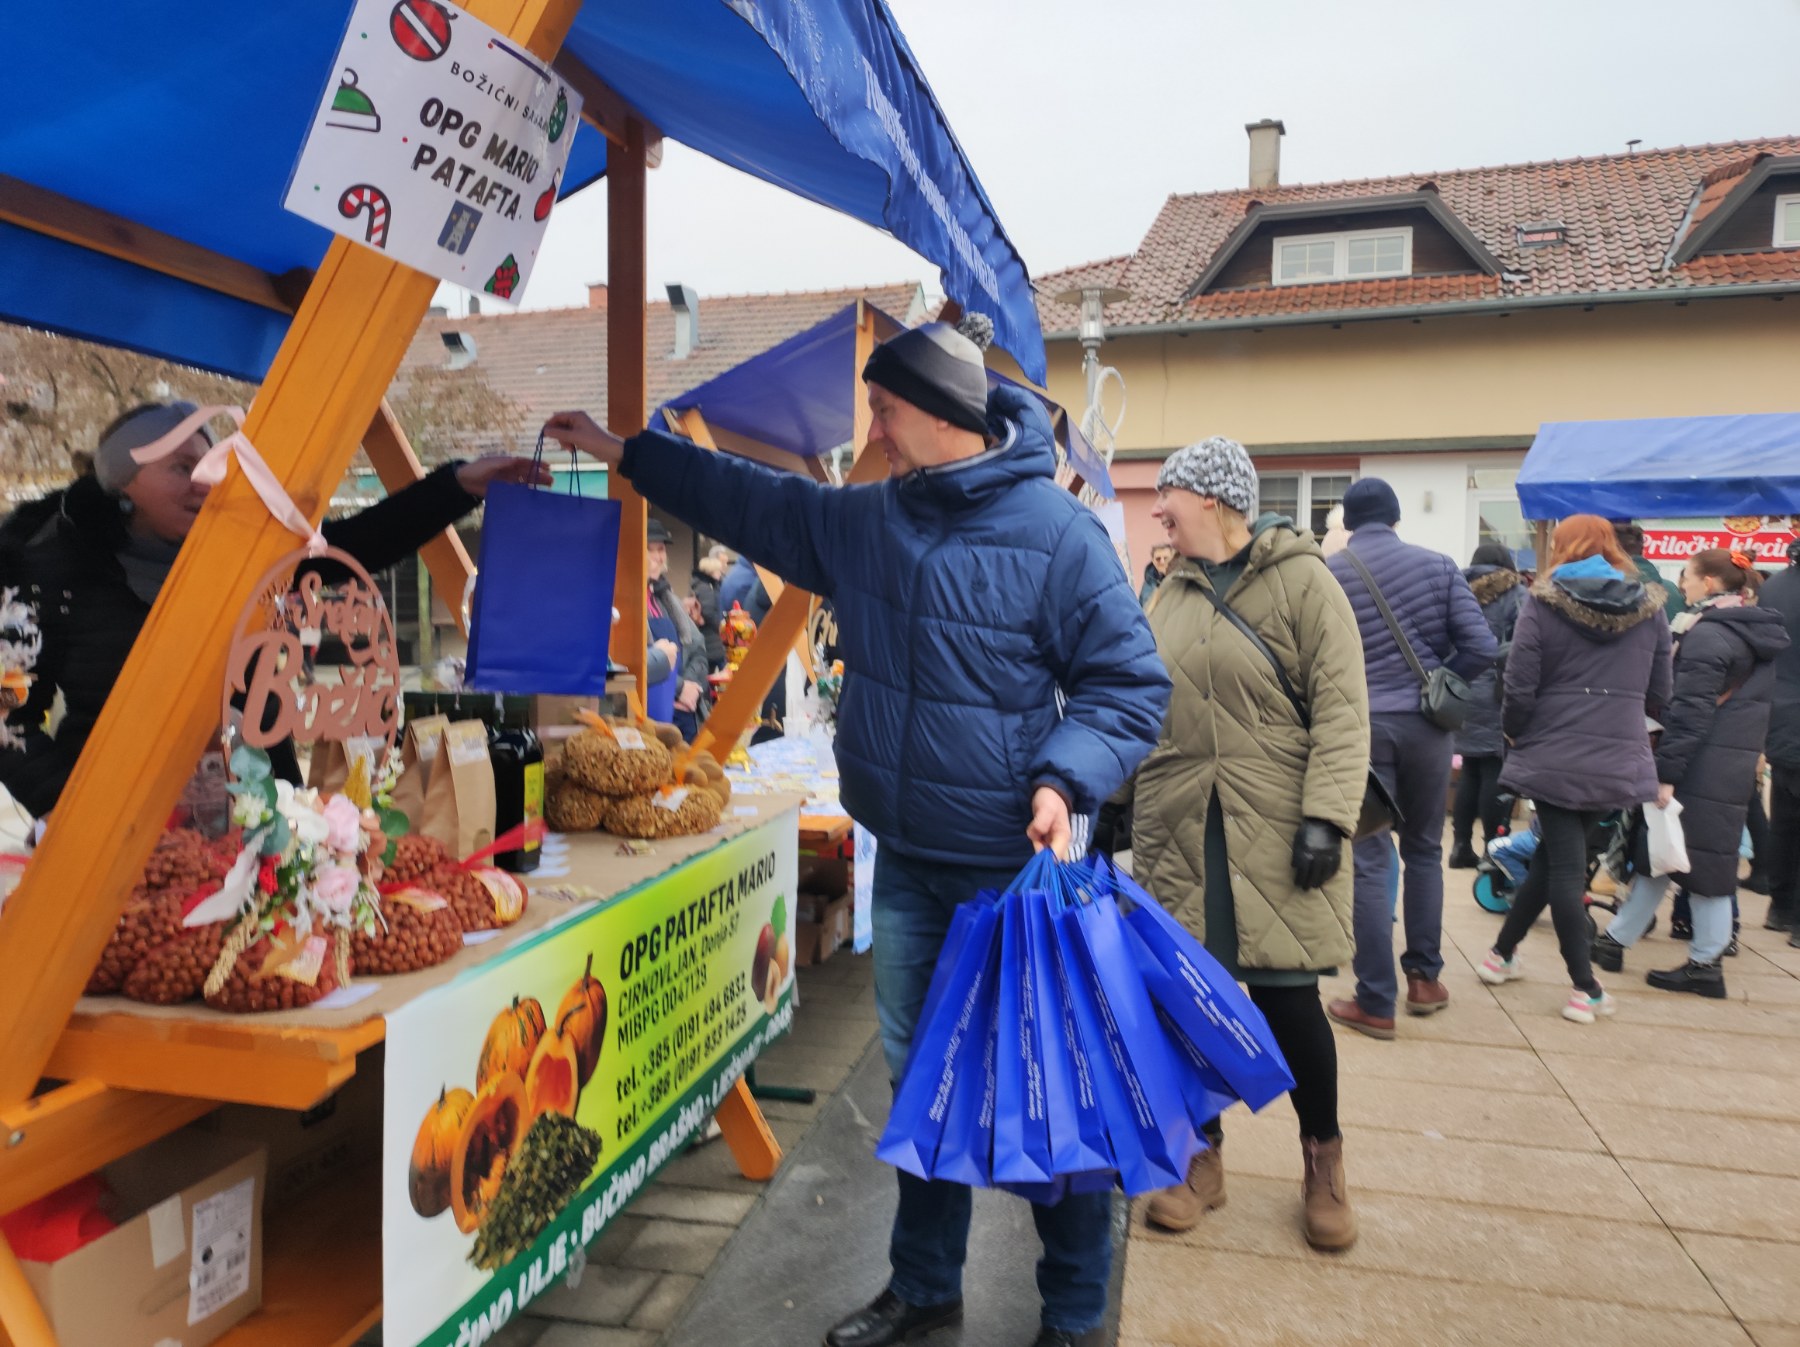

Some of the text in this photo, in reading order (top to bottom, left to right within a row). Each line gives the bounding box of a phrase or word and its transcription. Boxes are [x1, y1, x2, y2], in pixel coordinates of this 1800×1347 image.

[450, 60, 518, 112] BOŽIĆNI
[410, 143, 522, 222] PATAFTA
[419, 97, 539, 185] OPG MARIO
[620, 851, 775, 980] OPG PATAFTA MARIO
[617, 1000, 659, 1051] MIBPG
[517, 1231, 567, 1310] ULJE
[582, 1154, 645, 1246] BUČINO
